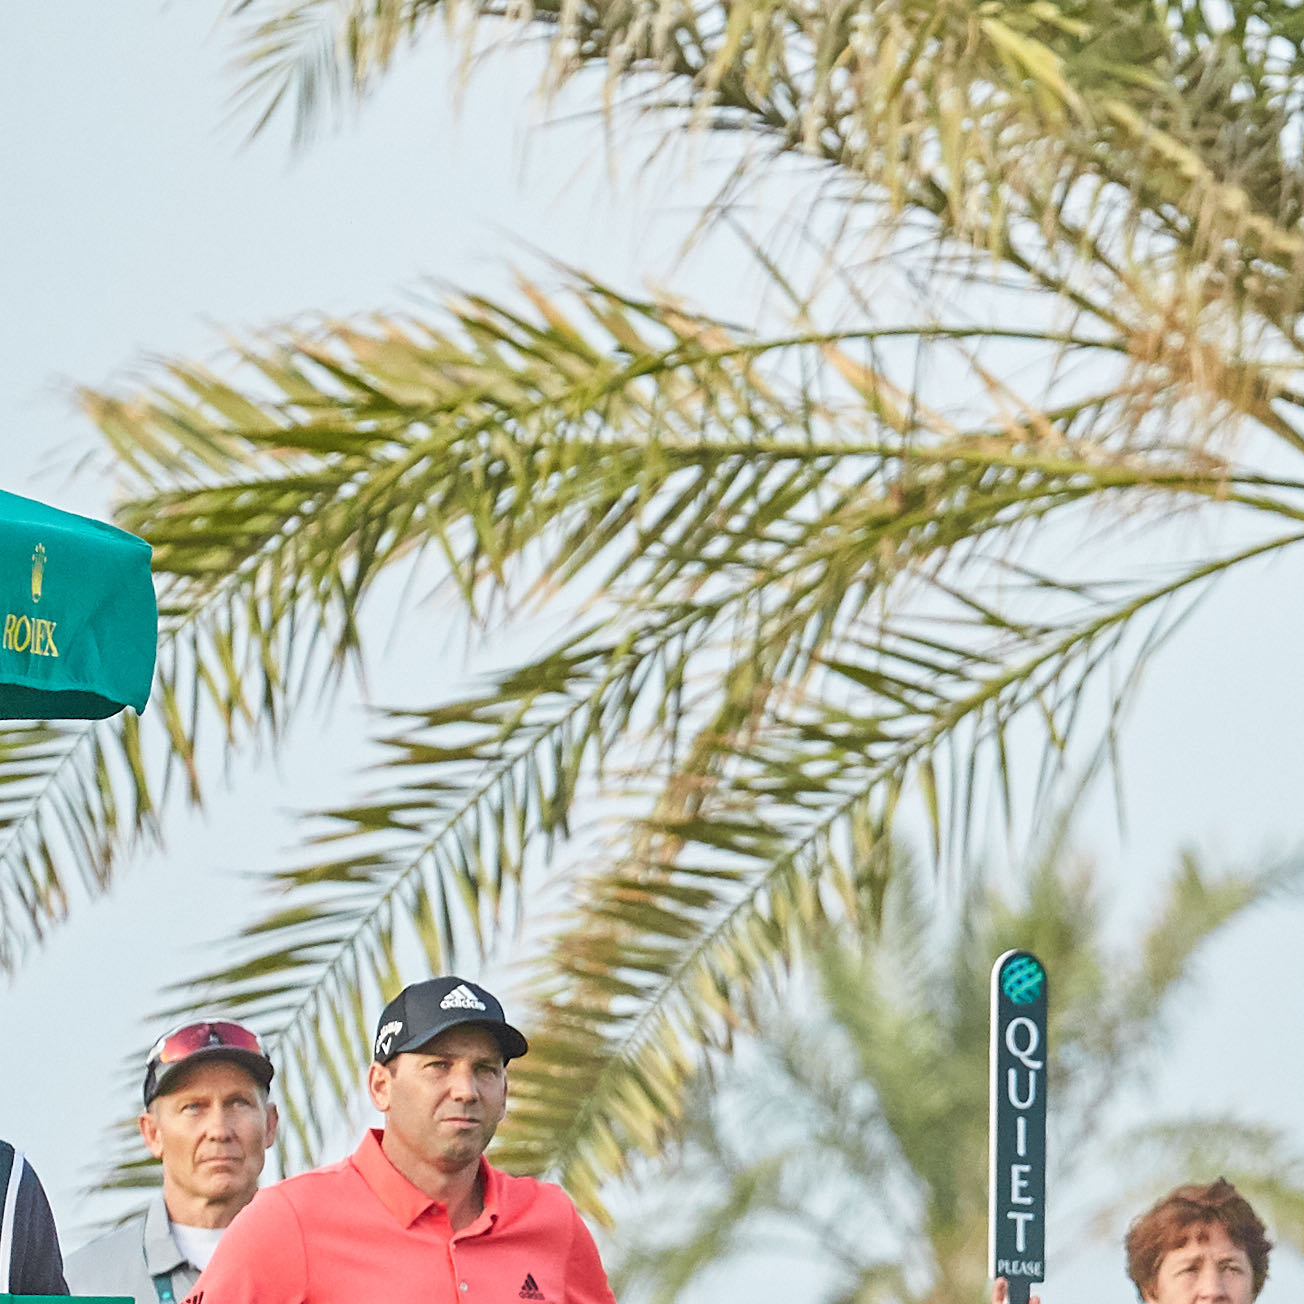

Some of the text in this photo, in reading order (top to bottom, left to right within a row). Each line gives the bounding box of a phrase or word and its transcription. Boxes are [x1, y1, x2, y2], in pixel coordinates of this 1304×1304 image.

[3, 613, 59, 657] ROLEX
[440, 1000, 486, 1011] adidas
[1005, 1016, 1043, 1253] QUIET
[998, 1259, 1042, 1277] PLEASE
